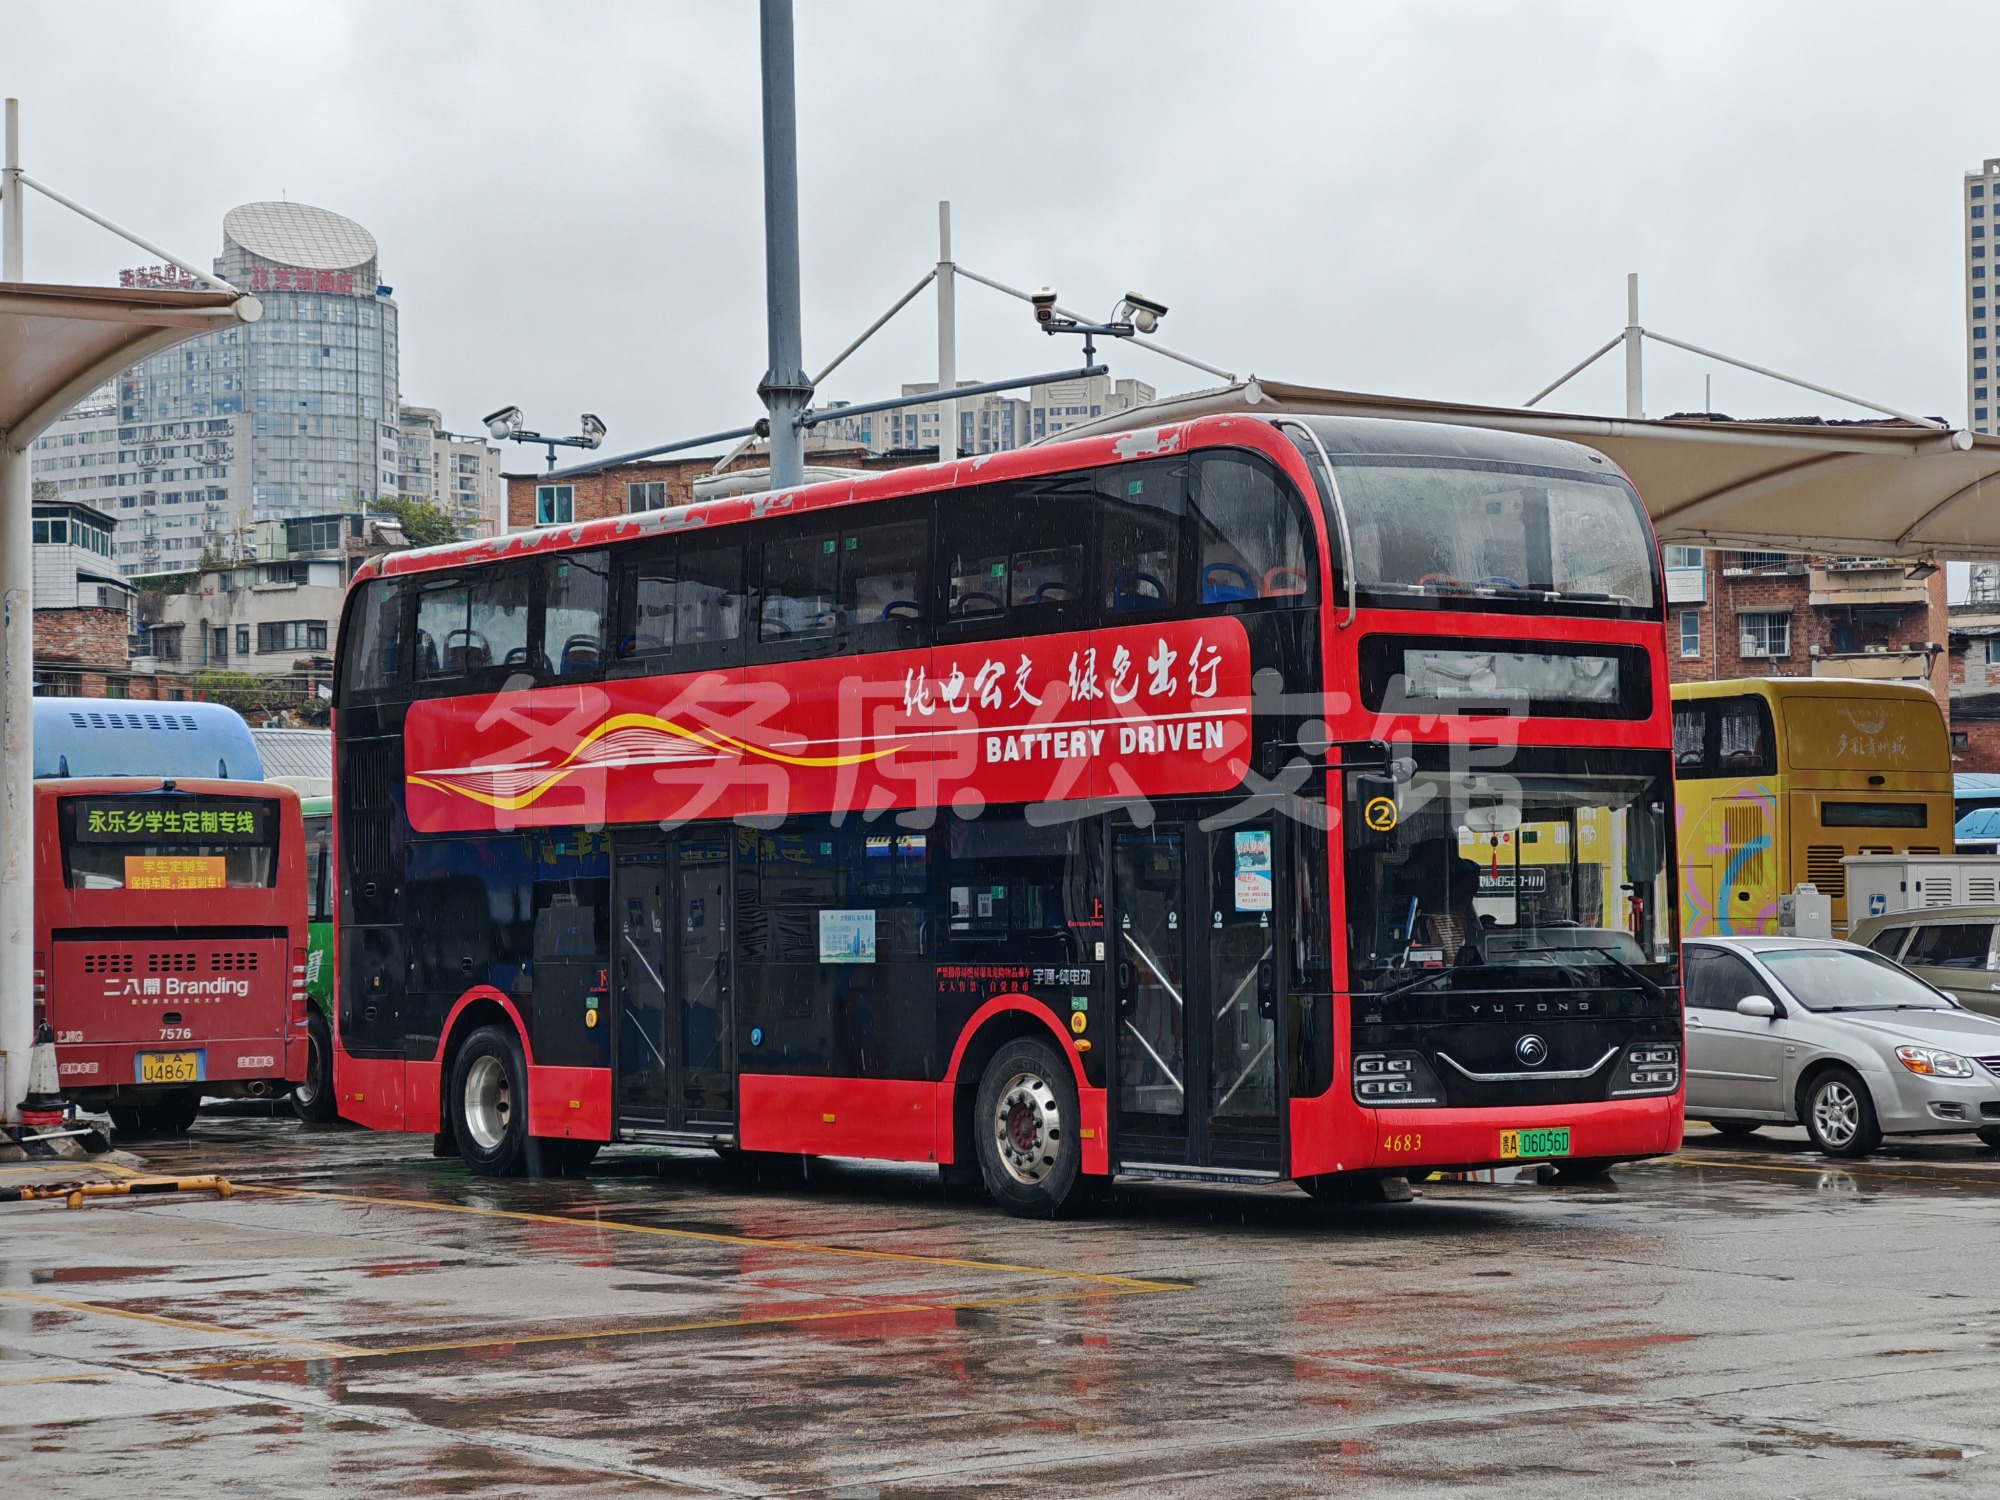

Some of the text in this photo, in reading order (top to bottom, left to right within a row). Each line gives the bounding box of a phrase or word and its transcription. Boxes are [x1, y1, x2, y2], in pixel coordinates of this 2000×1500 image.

[903, 636, 1223, 716] 纯电公交 绿色出行
[986, 720, 1223, 763] BATTERY DRIVEN
[88, 810, 254, 835] 永乐乡学生定制专线
[143, 860, 208, 873] 学生定制车
[1090, 898, 1104, 919] 上
[166, 977, 249, 997] Branding
[596, 969, 607, 988] 下
[1471, 1002, 1589, 1013] YUTONG
[57, 1031, 83, 1043] LNG
[159, 1028, 191, 1040] 7576
[59, 1062, 98, 1074] 保持车距
[143, 1063, 194, 1081] U4867
[1384, 1134, 1422, 1152] 4683
